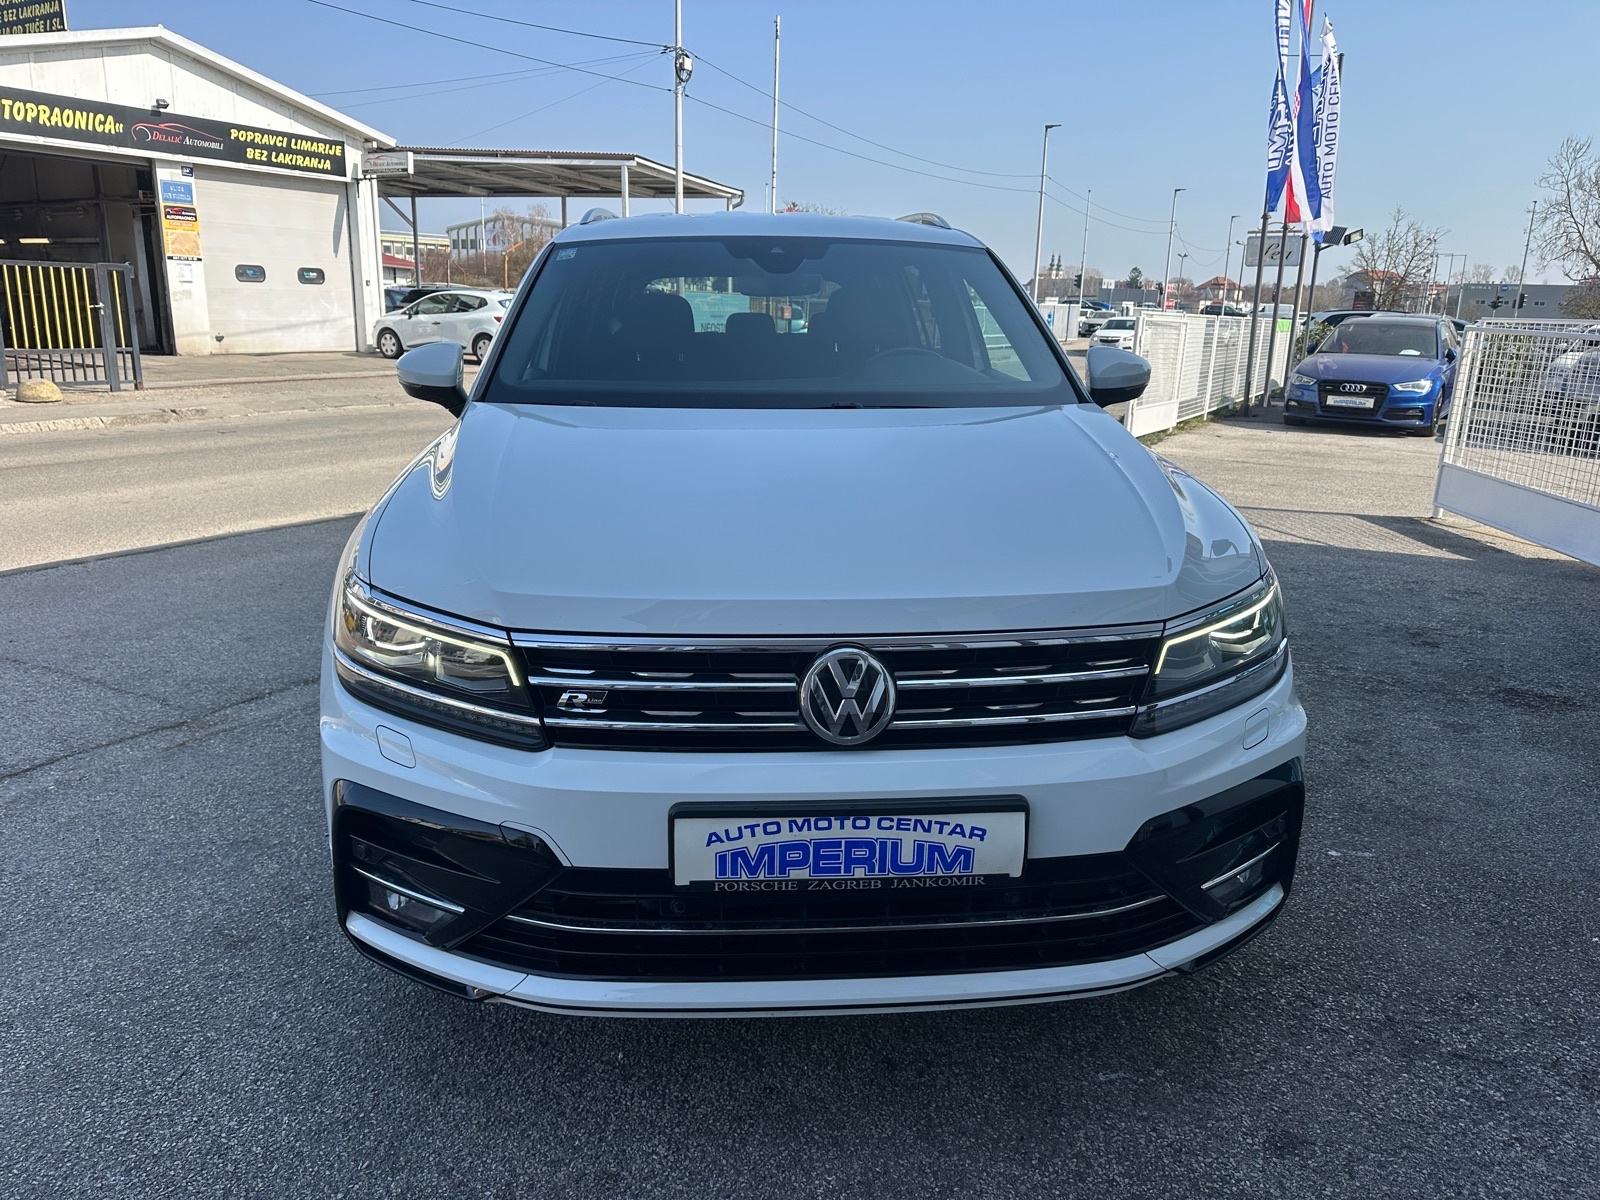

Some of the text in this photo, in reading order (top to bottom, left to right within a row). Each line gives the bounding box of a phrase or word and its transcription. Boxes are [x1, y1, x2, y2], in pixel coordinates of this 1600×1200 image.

[3, 0, 60, 22] BEZ LAKIRANJA
[25, 18, 45, 34] TUČE
[46, 20, 50, 31] I
[52, 17, 64, 30] SL.
[230, 128, 342, 156] POPRAVCI LIMARIJE
[1323, 111, 1339, 156] MOTO
[246, 147, 331, 170] BEZ LAKIRANJA
[1321, 162, 1335, 200] AUTO
[706, 816, 988, 847] AUTO MOTO CENTAR
[715, 837, 976, 880] IMPERIUM
[713, 875, 987, 893] PORSCHE ZAGREB JANKOMIR
